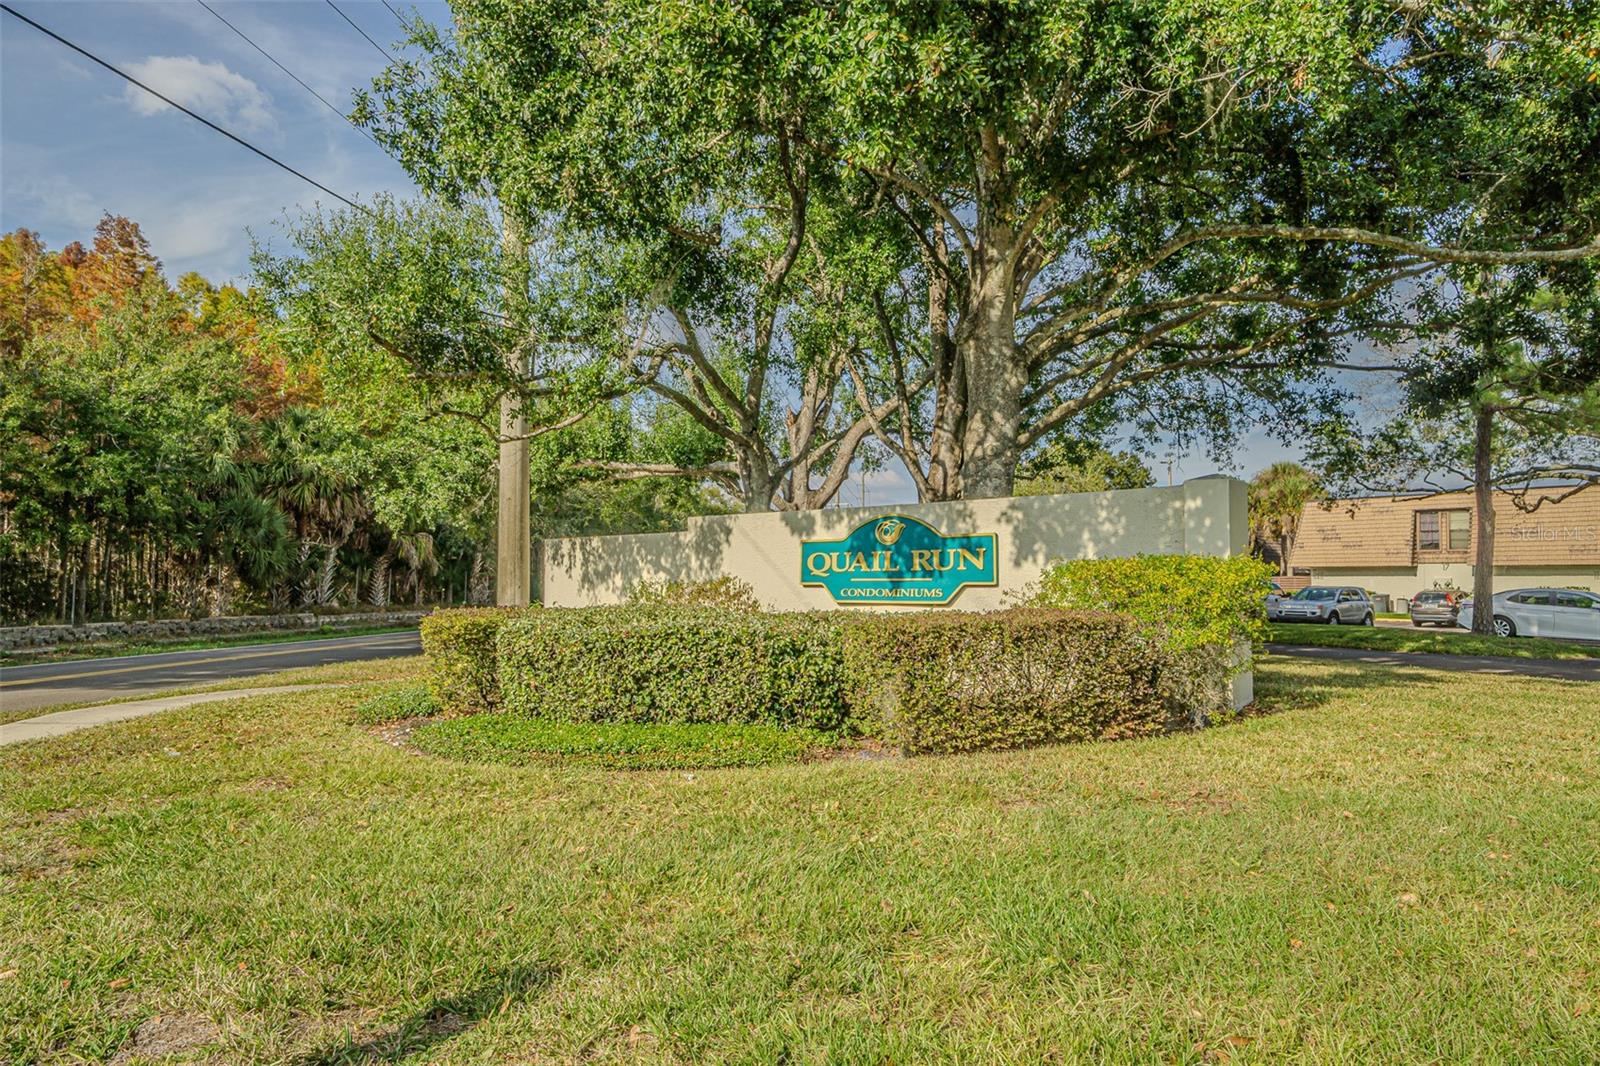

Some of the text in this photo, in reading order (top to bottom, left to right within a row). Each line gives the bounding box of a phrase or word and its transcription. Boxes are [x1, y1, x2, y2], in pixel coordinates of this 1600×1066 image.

[807, 548, 986, 576] QUAIL RUN
[840, 588, 943, 598] CONDOMINIUMS
